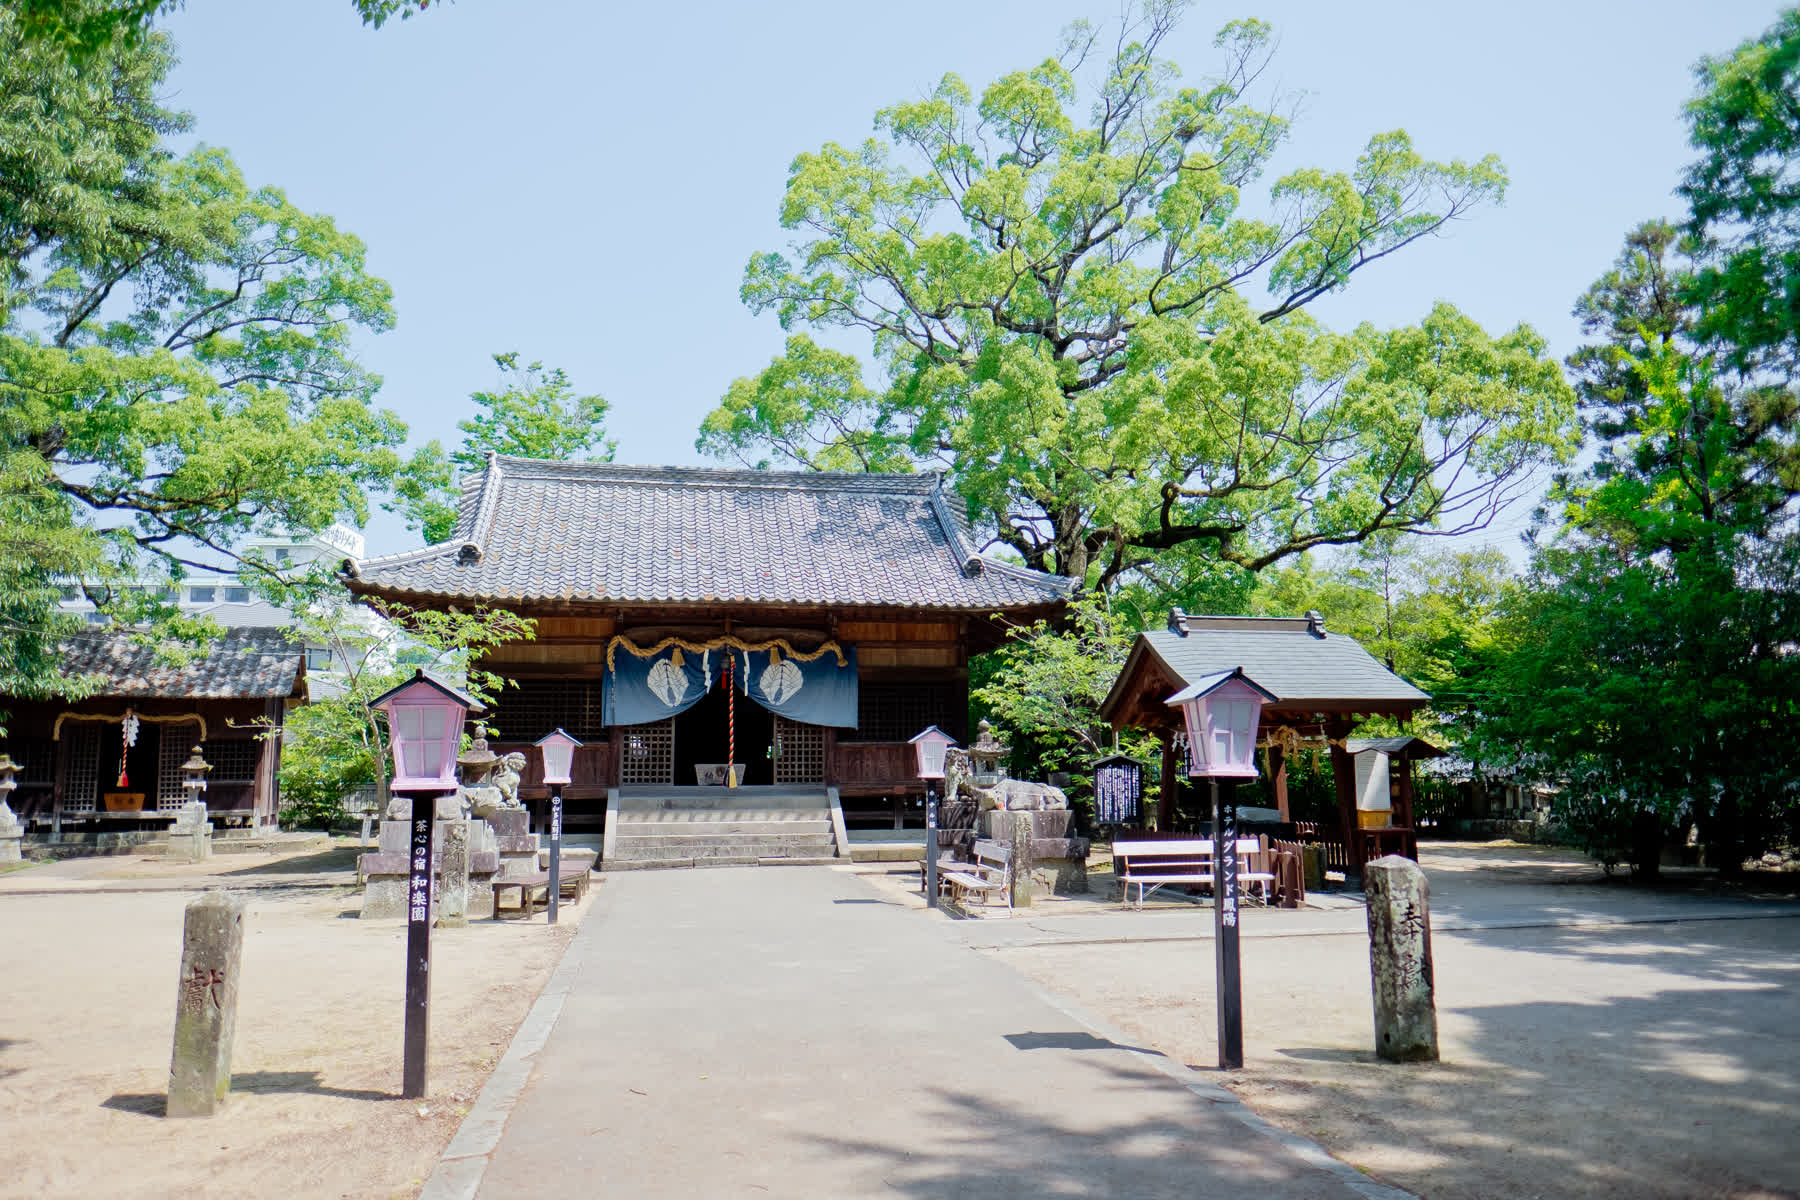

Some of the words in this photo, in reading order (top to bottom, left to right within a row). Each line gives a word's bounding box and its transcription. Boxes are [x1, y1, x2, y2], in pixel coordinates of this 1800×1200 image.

[414, 819, 428, 870] 茶心の宿
[1222, 804, 1236, 928] ホテルグランド鳳陽
[411, 875, 428, 922] 和楽園
